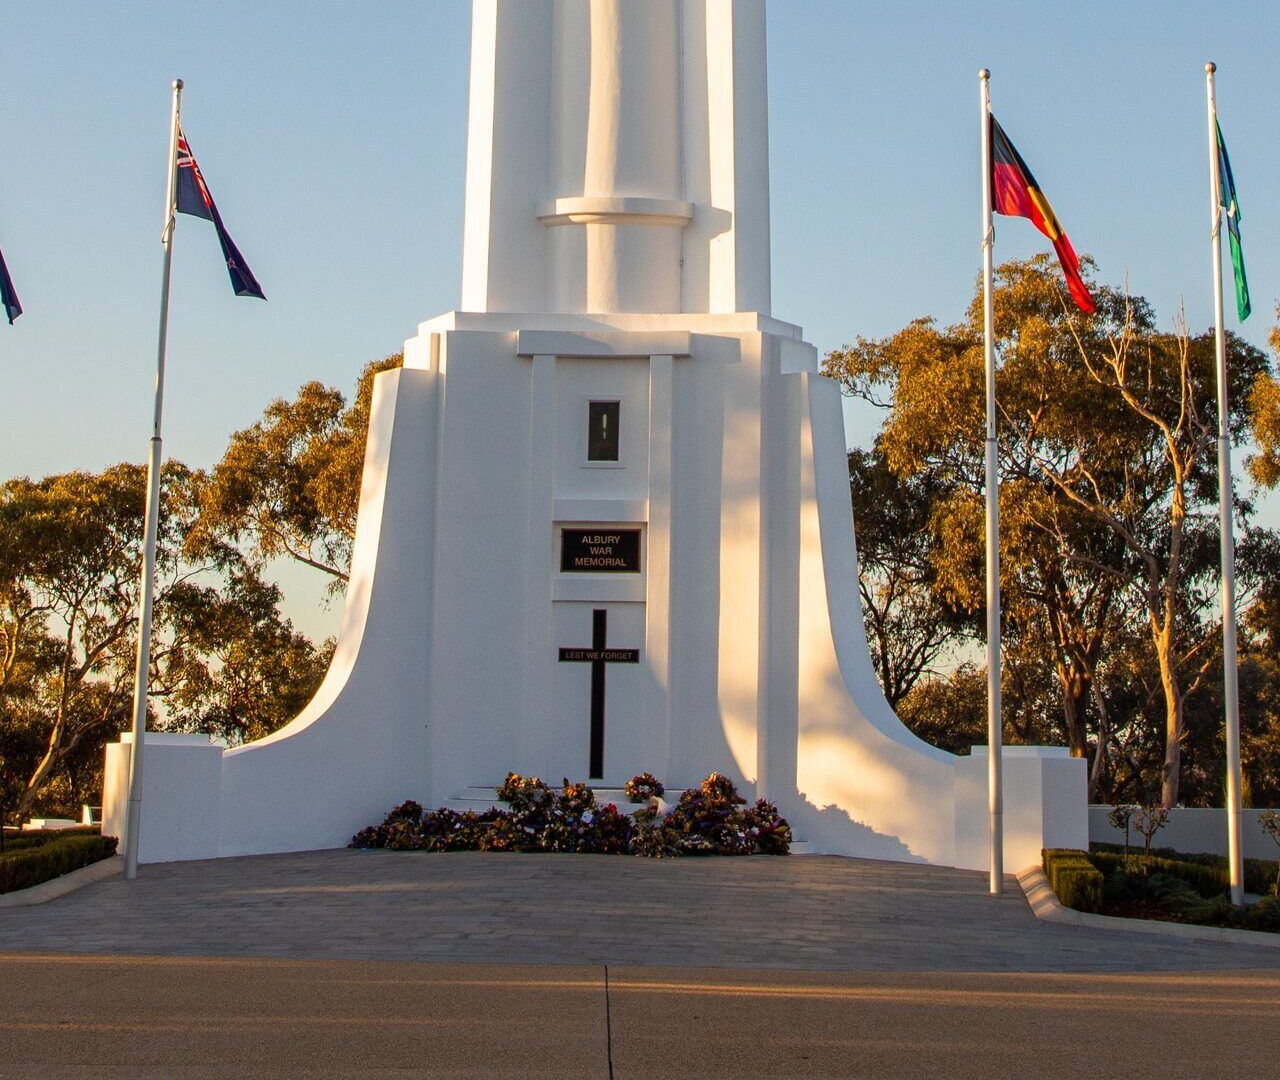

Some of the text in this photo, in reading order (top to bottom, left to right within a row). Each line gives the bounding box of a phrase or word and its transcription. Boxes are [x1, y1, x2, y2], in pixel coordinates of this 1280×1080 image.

[581, 535, 620, 544] ALBURY
[589, 546, 612, 555] WAR
[574, 557, 627, 567] MEMORIAL
[565, 651, 585, 659] LEST
[600, 652, 632, 660] FORGET
